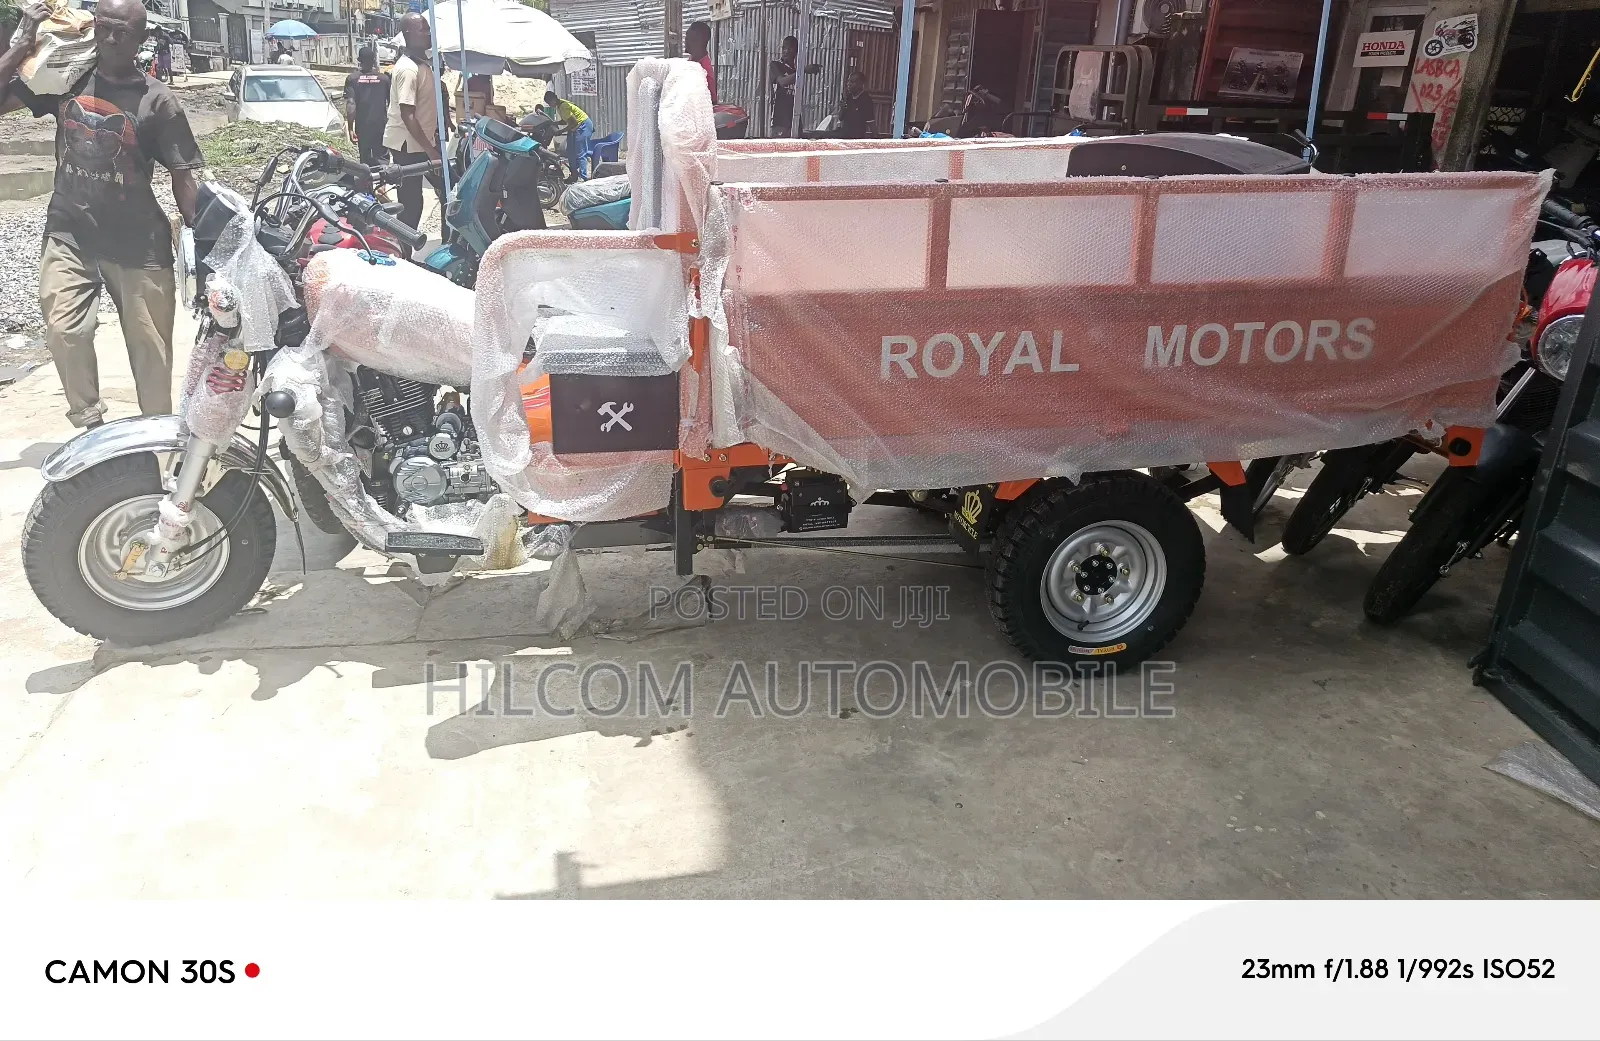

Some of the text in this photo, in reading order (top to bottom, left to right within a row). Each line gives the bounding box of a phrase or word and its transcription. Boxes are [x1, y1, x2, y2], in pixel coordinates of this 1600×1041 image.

[1362, 40, 1406, 51] HONDA
[880, 317, 1376, 379] ROYAL MOTORS
